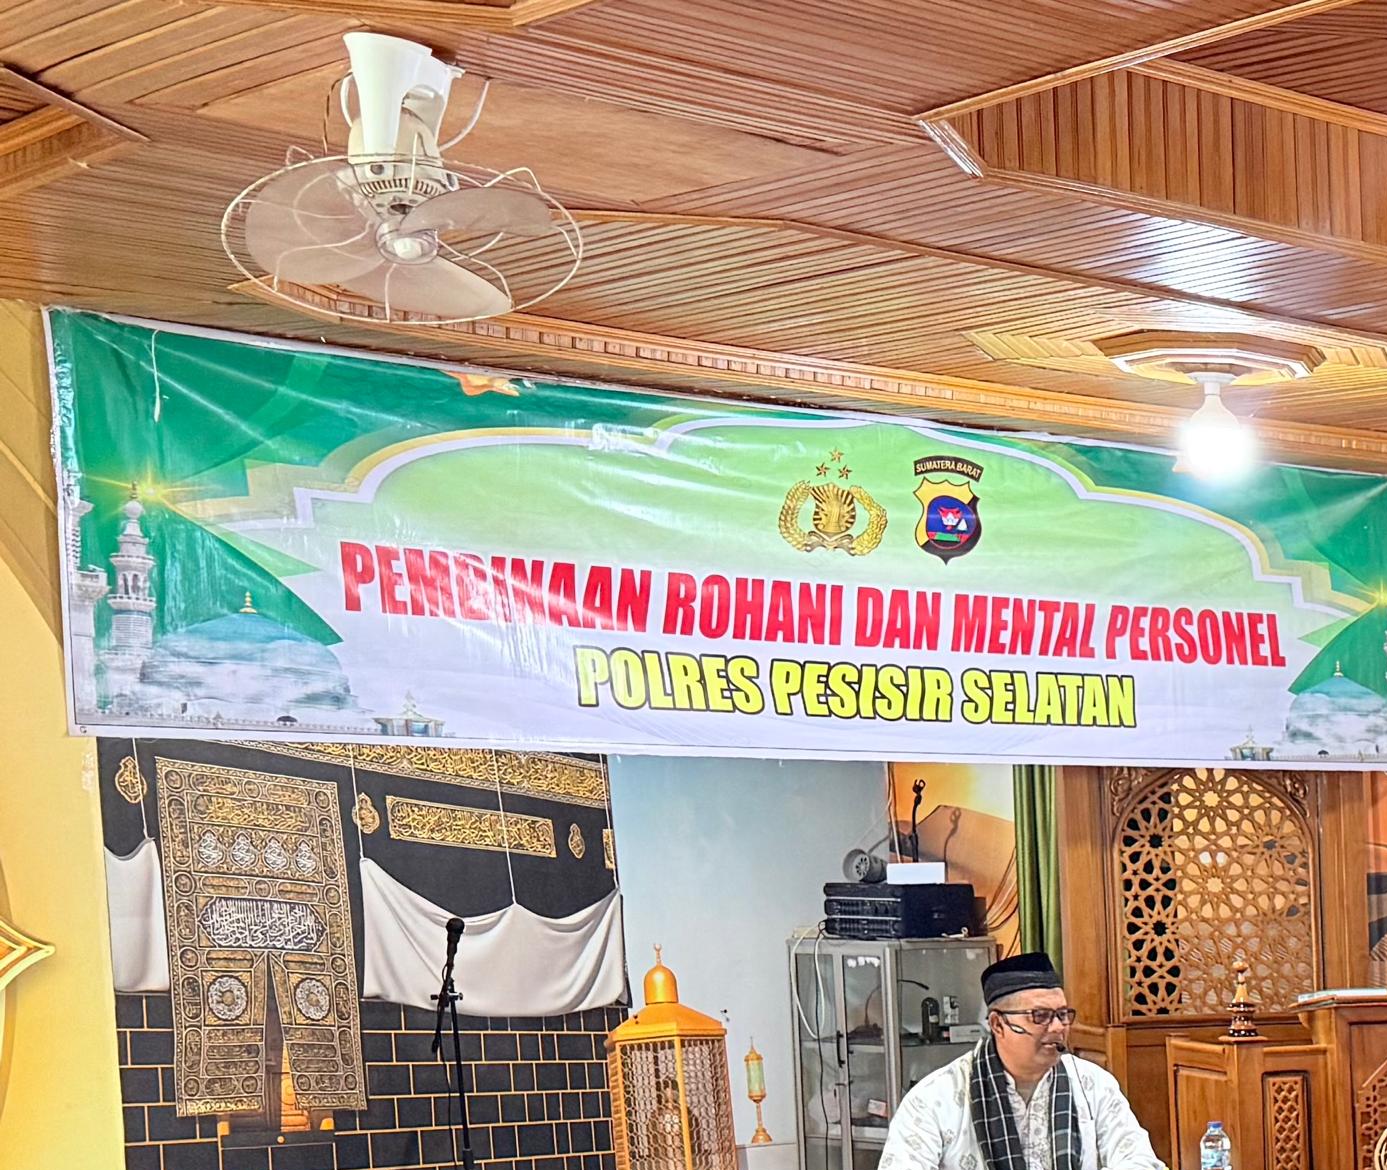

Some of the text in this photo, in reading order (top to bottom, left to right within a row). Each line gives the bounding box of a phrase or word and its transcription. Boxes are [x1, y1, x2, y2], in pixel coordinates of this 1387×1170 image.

[916, 460, 981, 478] SUMATERA BARAT
[339, 541, 1287, 668] PEMBINAAN ROHANI DAN MENTAL PERSONEL
[573, 645, 1138, 729] POLRES PESISIR SELATAN
